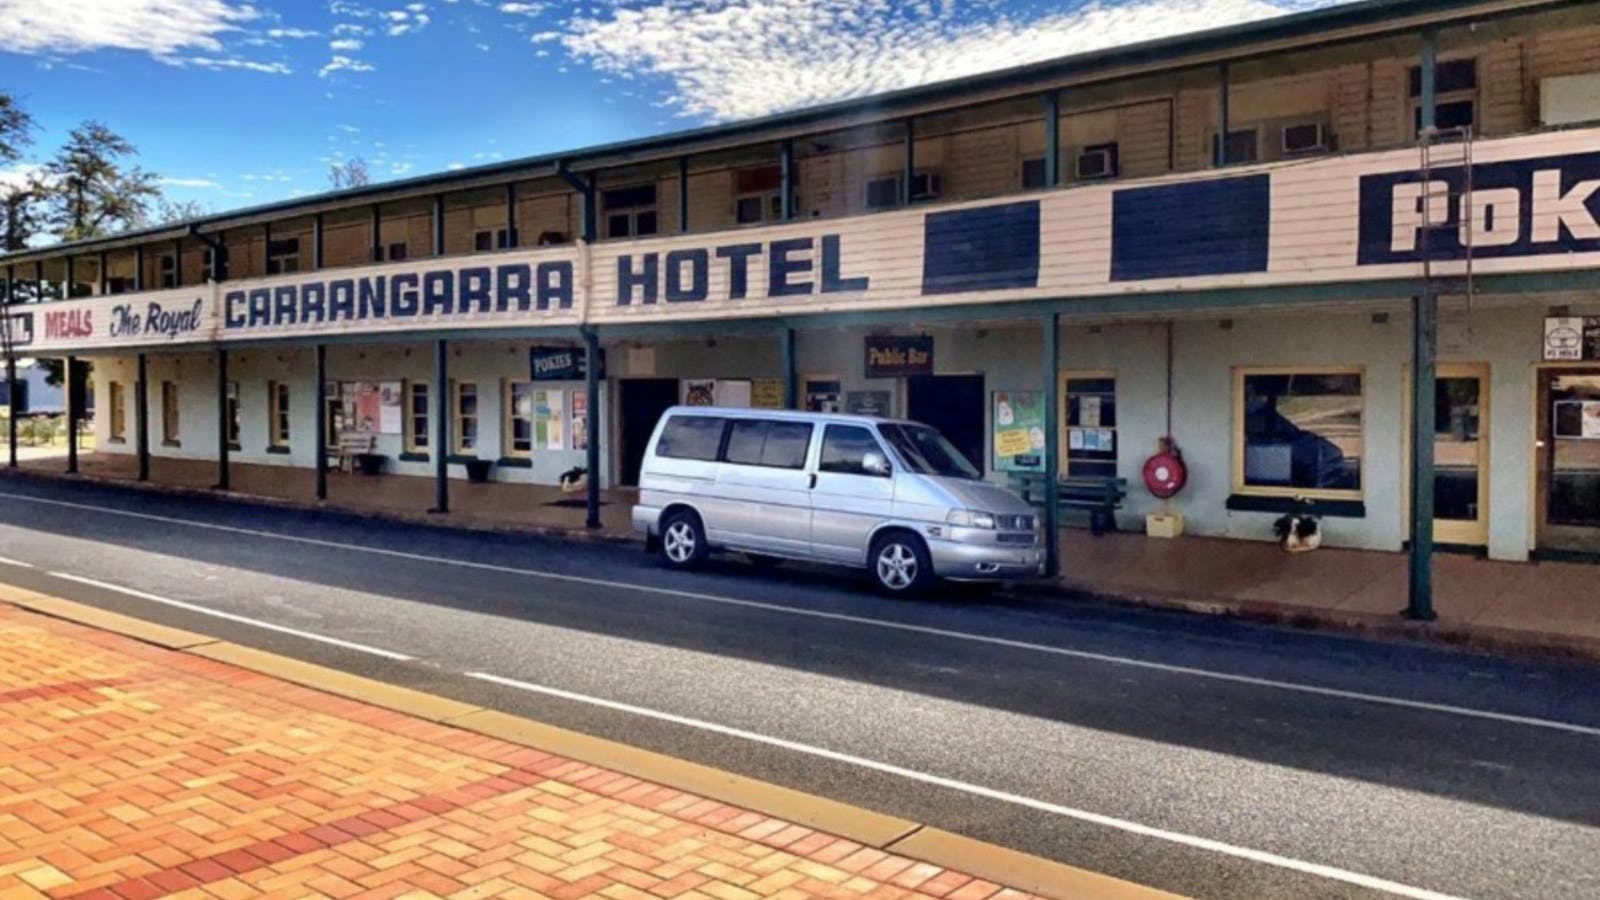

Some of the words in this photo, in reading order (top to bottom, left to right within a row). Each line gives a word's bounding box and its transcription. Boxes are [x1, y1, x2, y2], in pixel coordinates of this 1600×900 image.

[225, 260, 574, 328] CARRANGARRA
[617, 234, 869, 305] HOTEL
[45, 308, 92, 339] MEALS
[110, 304, 141, 337] The
[144, 298, 202, 340] Royal
[869, 347, 905, 365] Public
[908, 347, 929, 364] Bar
